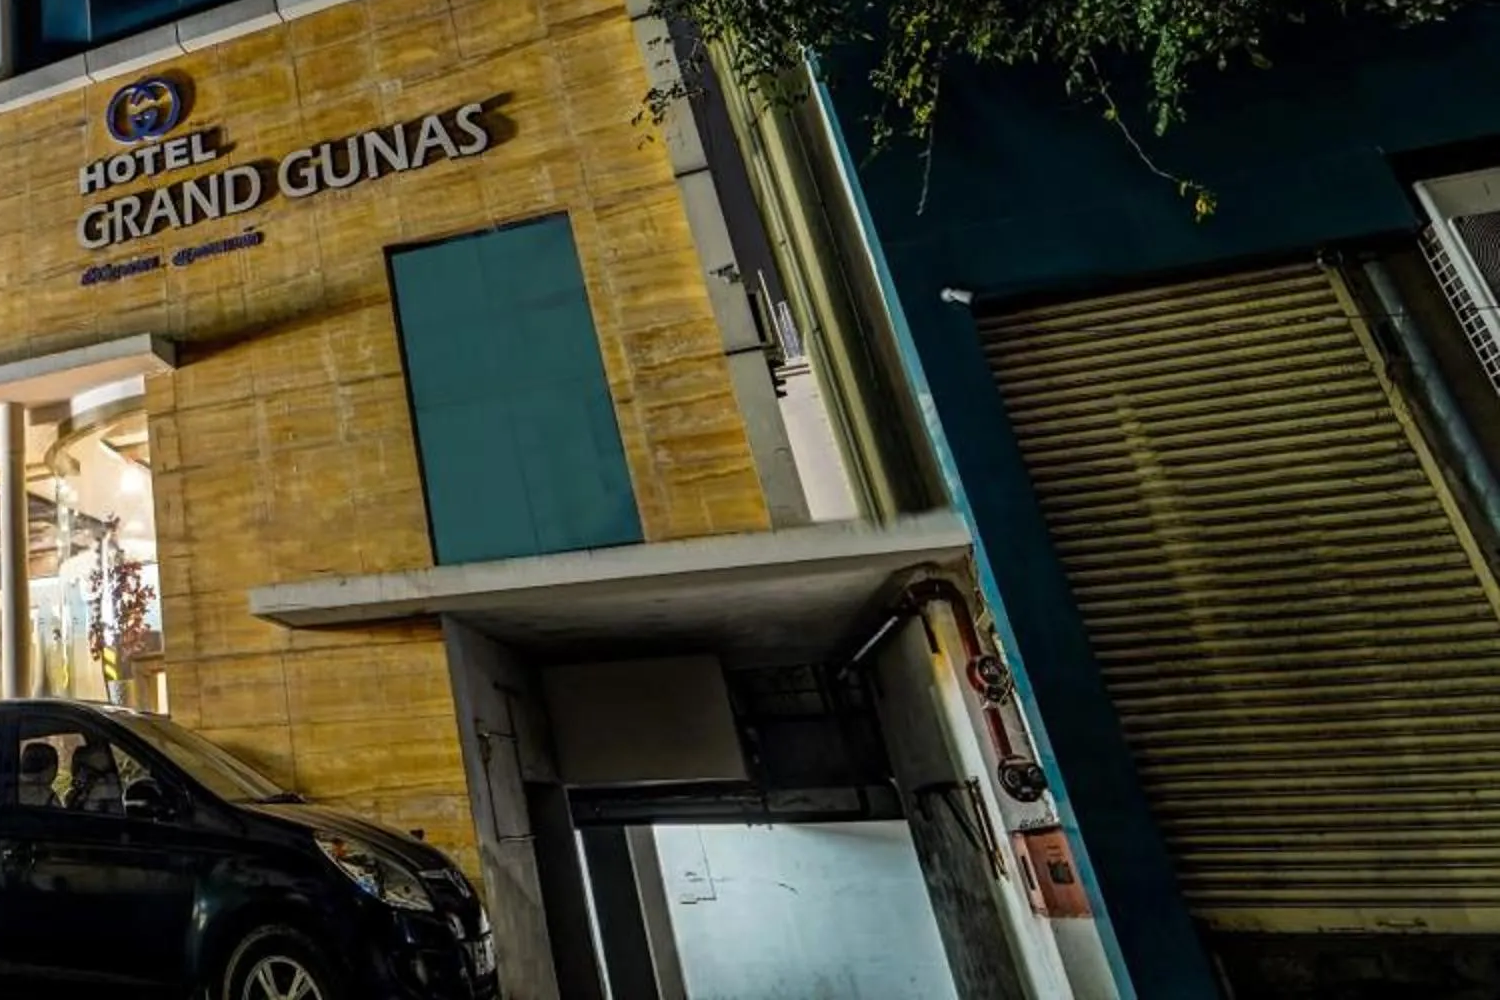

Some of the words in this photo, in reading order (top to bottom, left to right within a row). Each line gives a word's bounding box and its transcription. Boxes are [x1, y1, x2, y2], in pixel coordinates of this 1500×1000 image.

[77, 166, 262, 250] GRAND
[277, 103, 489, 198] GUNAS
[79, 132, 216, 194] HOTEL
